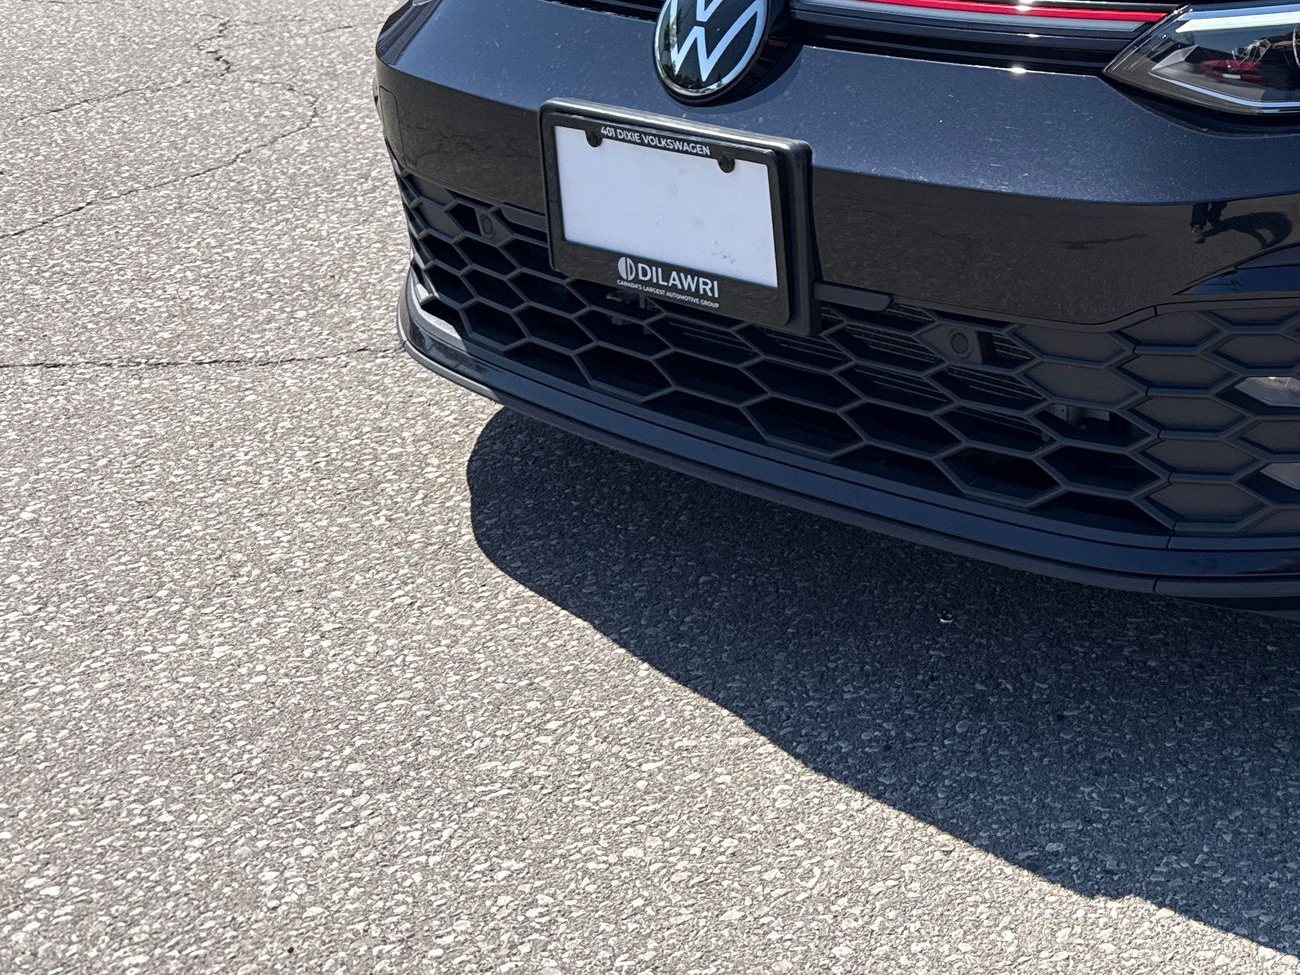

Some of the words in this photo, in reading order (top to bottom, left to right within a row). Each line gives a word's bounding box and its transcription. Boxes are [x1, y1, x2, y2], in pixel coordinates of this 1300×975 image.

[601, 126, 616, 137] 401
[617, 129, 641, 143] DIXIE
[641, 133, 711, 156] VOLKSWAGEN
[616, 279, 643, 290] CANADA'S
[643, 285, 666, 295] LARGEST
[666, 290, 700, 305] AUTOMOTIVE
[700, 298, 720, 310] GROUP
[637, 262, 719, 298] DILAWRI
